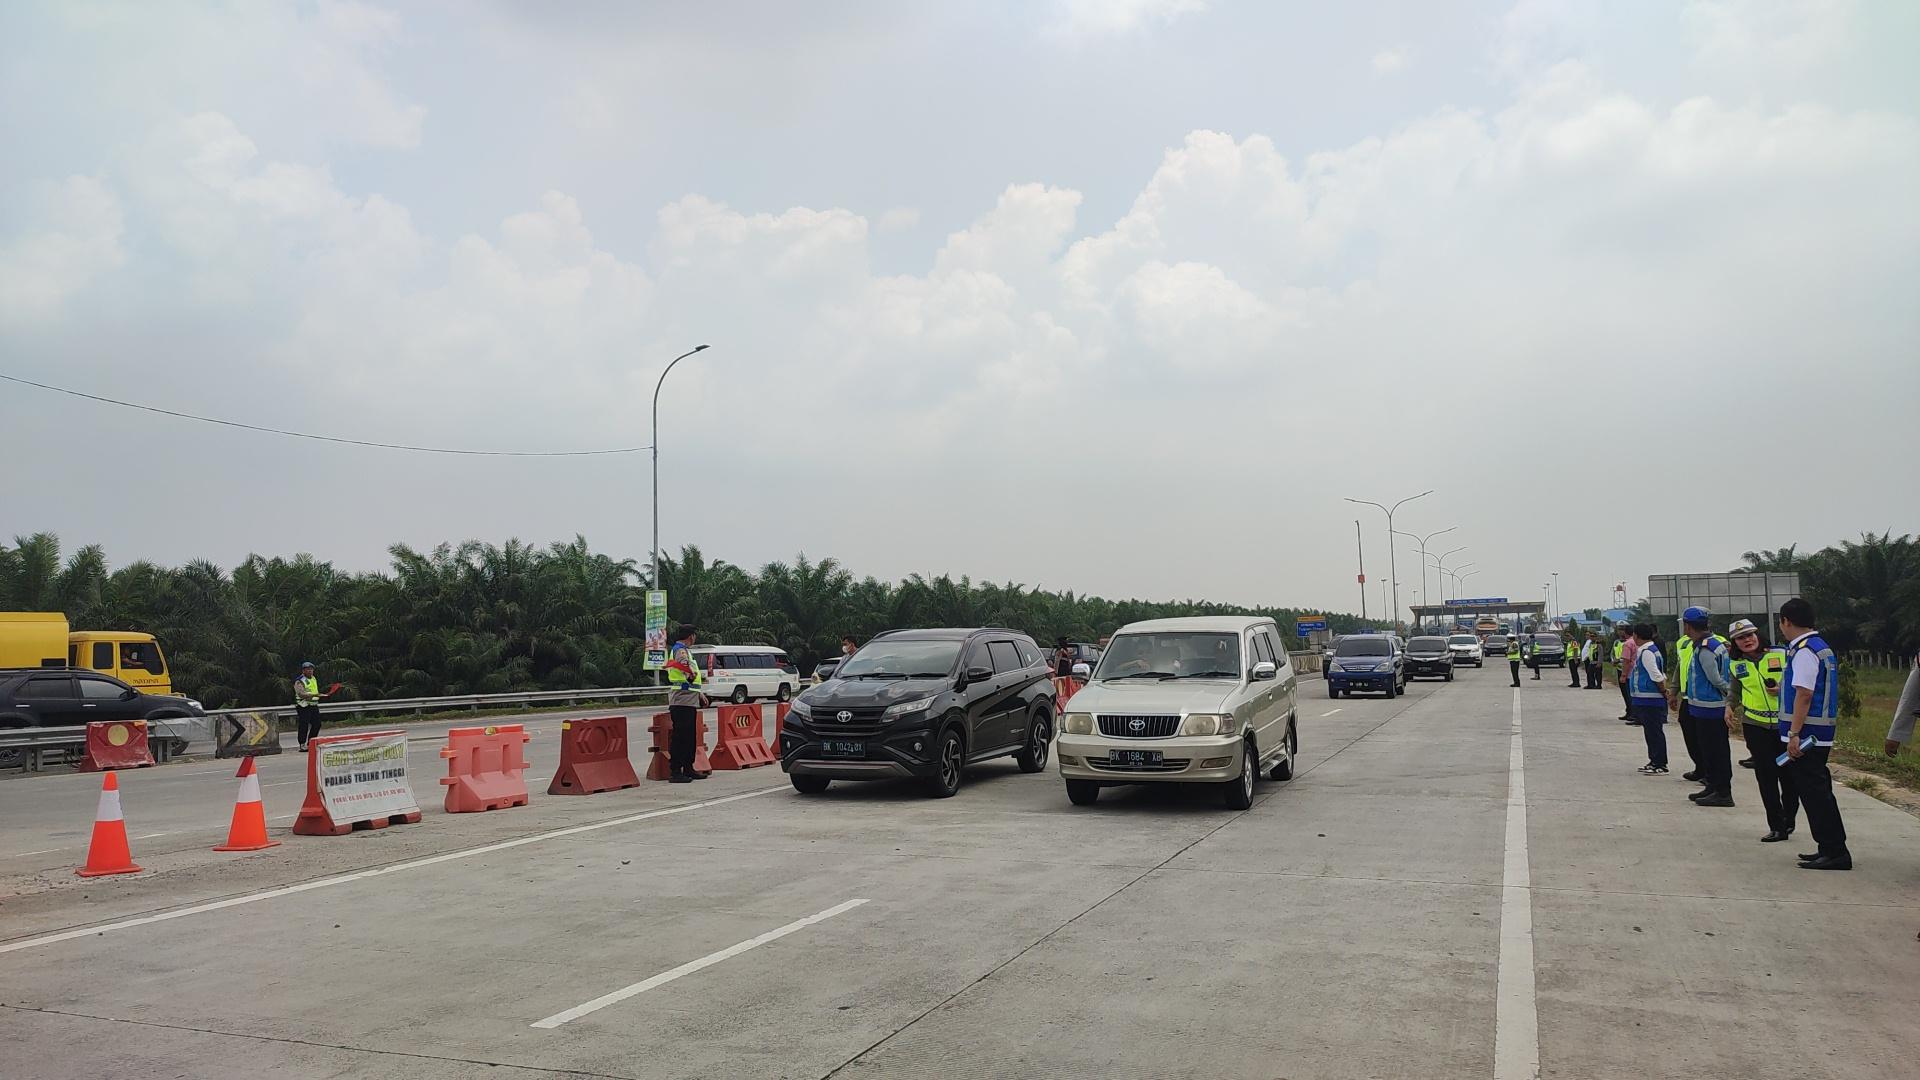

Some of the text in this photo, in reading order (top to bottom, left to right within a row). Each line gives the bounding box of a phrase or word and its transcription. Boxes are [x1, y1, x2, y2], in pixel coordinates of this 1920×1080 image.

[1110, 751, 1120, 761] BK
[1127, 751, 1145, 761] 1684
[325, 767, 405, 787] POLRES TEBING TINGGI
